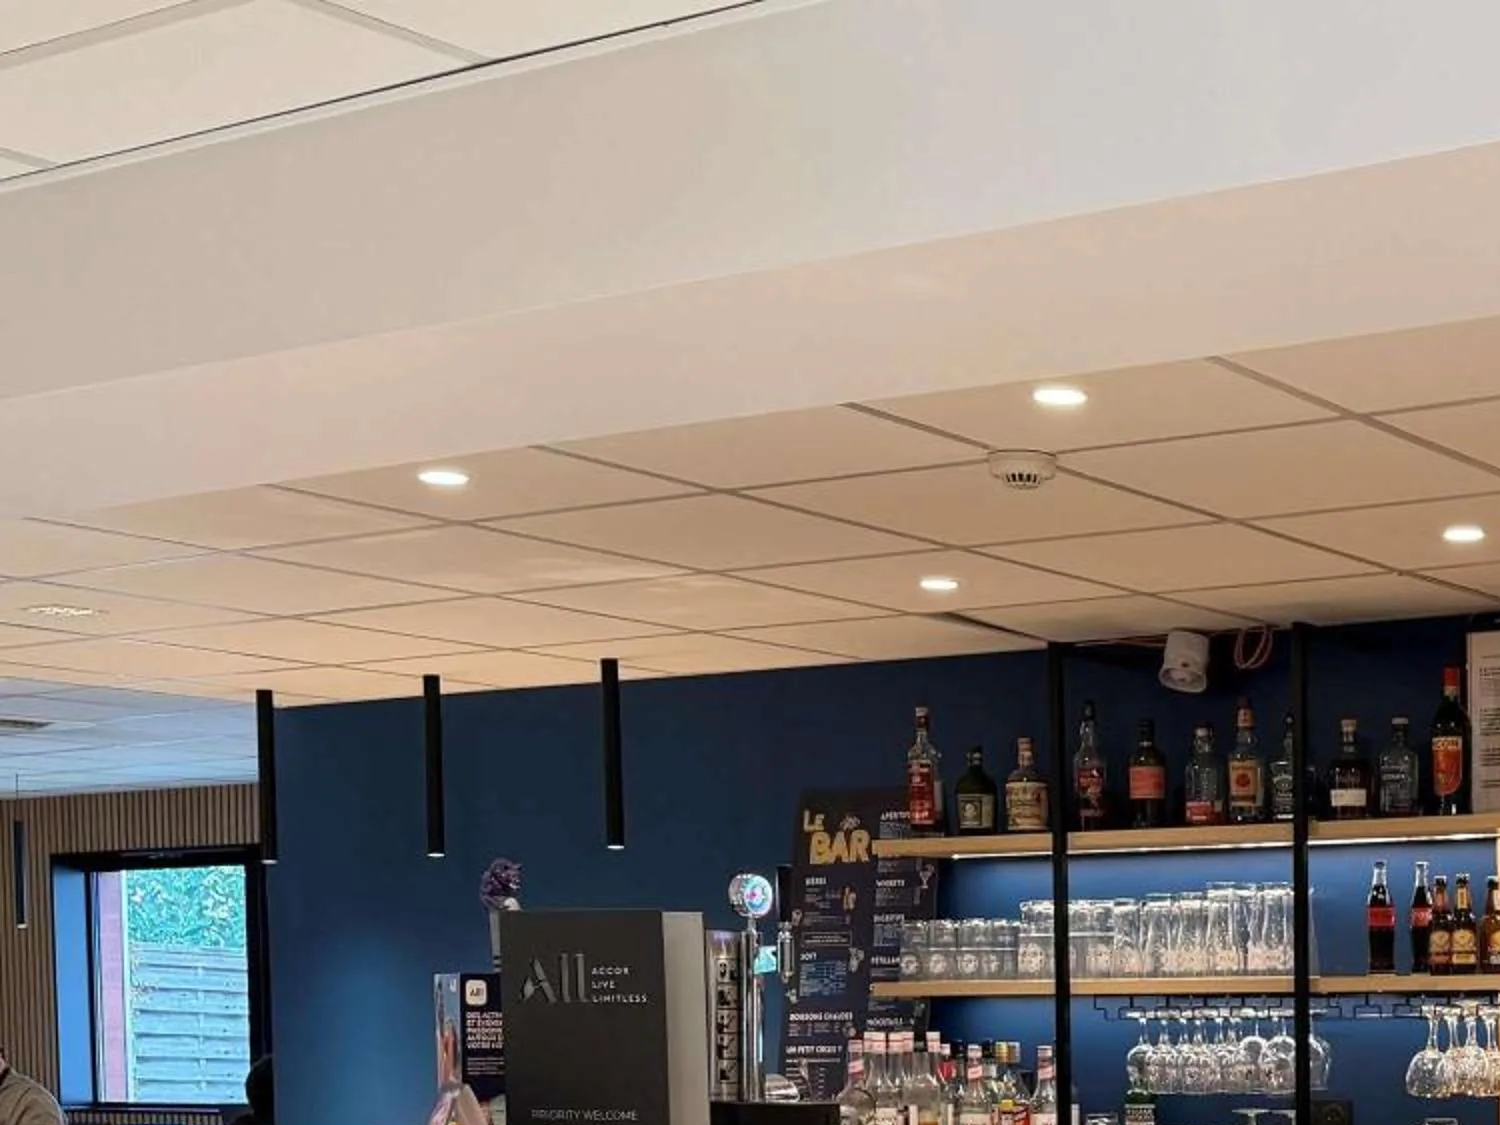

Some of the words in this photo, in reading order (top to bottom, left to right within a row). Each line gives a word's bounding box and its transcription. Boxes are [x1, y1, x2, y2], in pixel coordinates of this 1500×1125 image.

[803, 808, 825, 832] LE
[810, 829, 871, 865] BAR
[591, 966, 630, 976] ACCOR
[591, 980, 616, 989] LIVE
[591, 994, 648, 1003] LIMITLESS
[531, 1108, 581, 1121] PRIORITY
[582, 1108, 639, 1121] WELCOME
